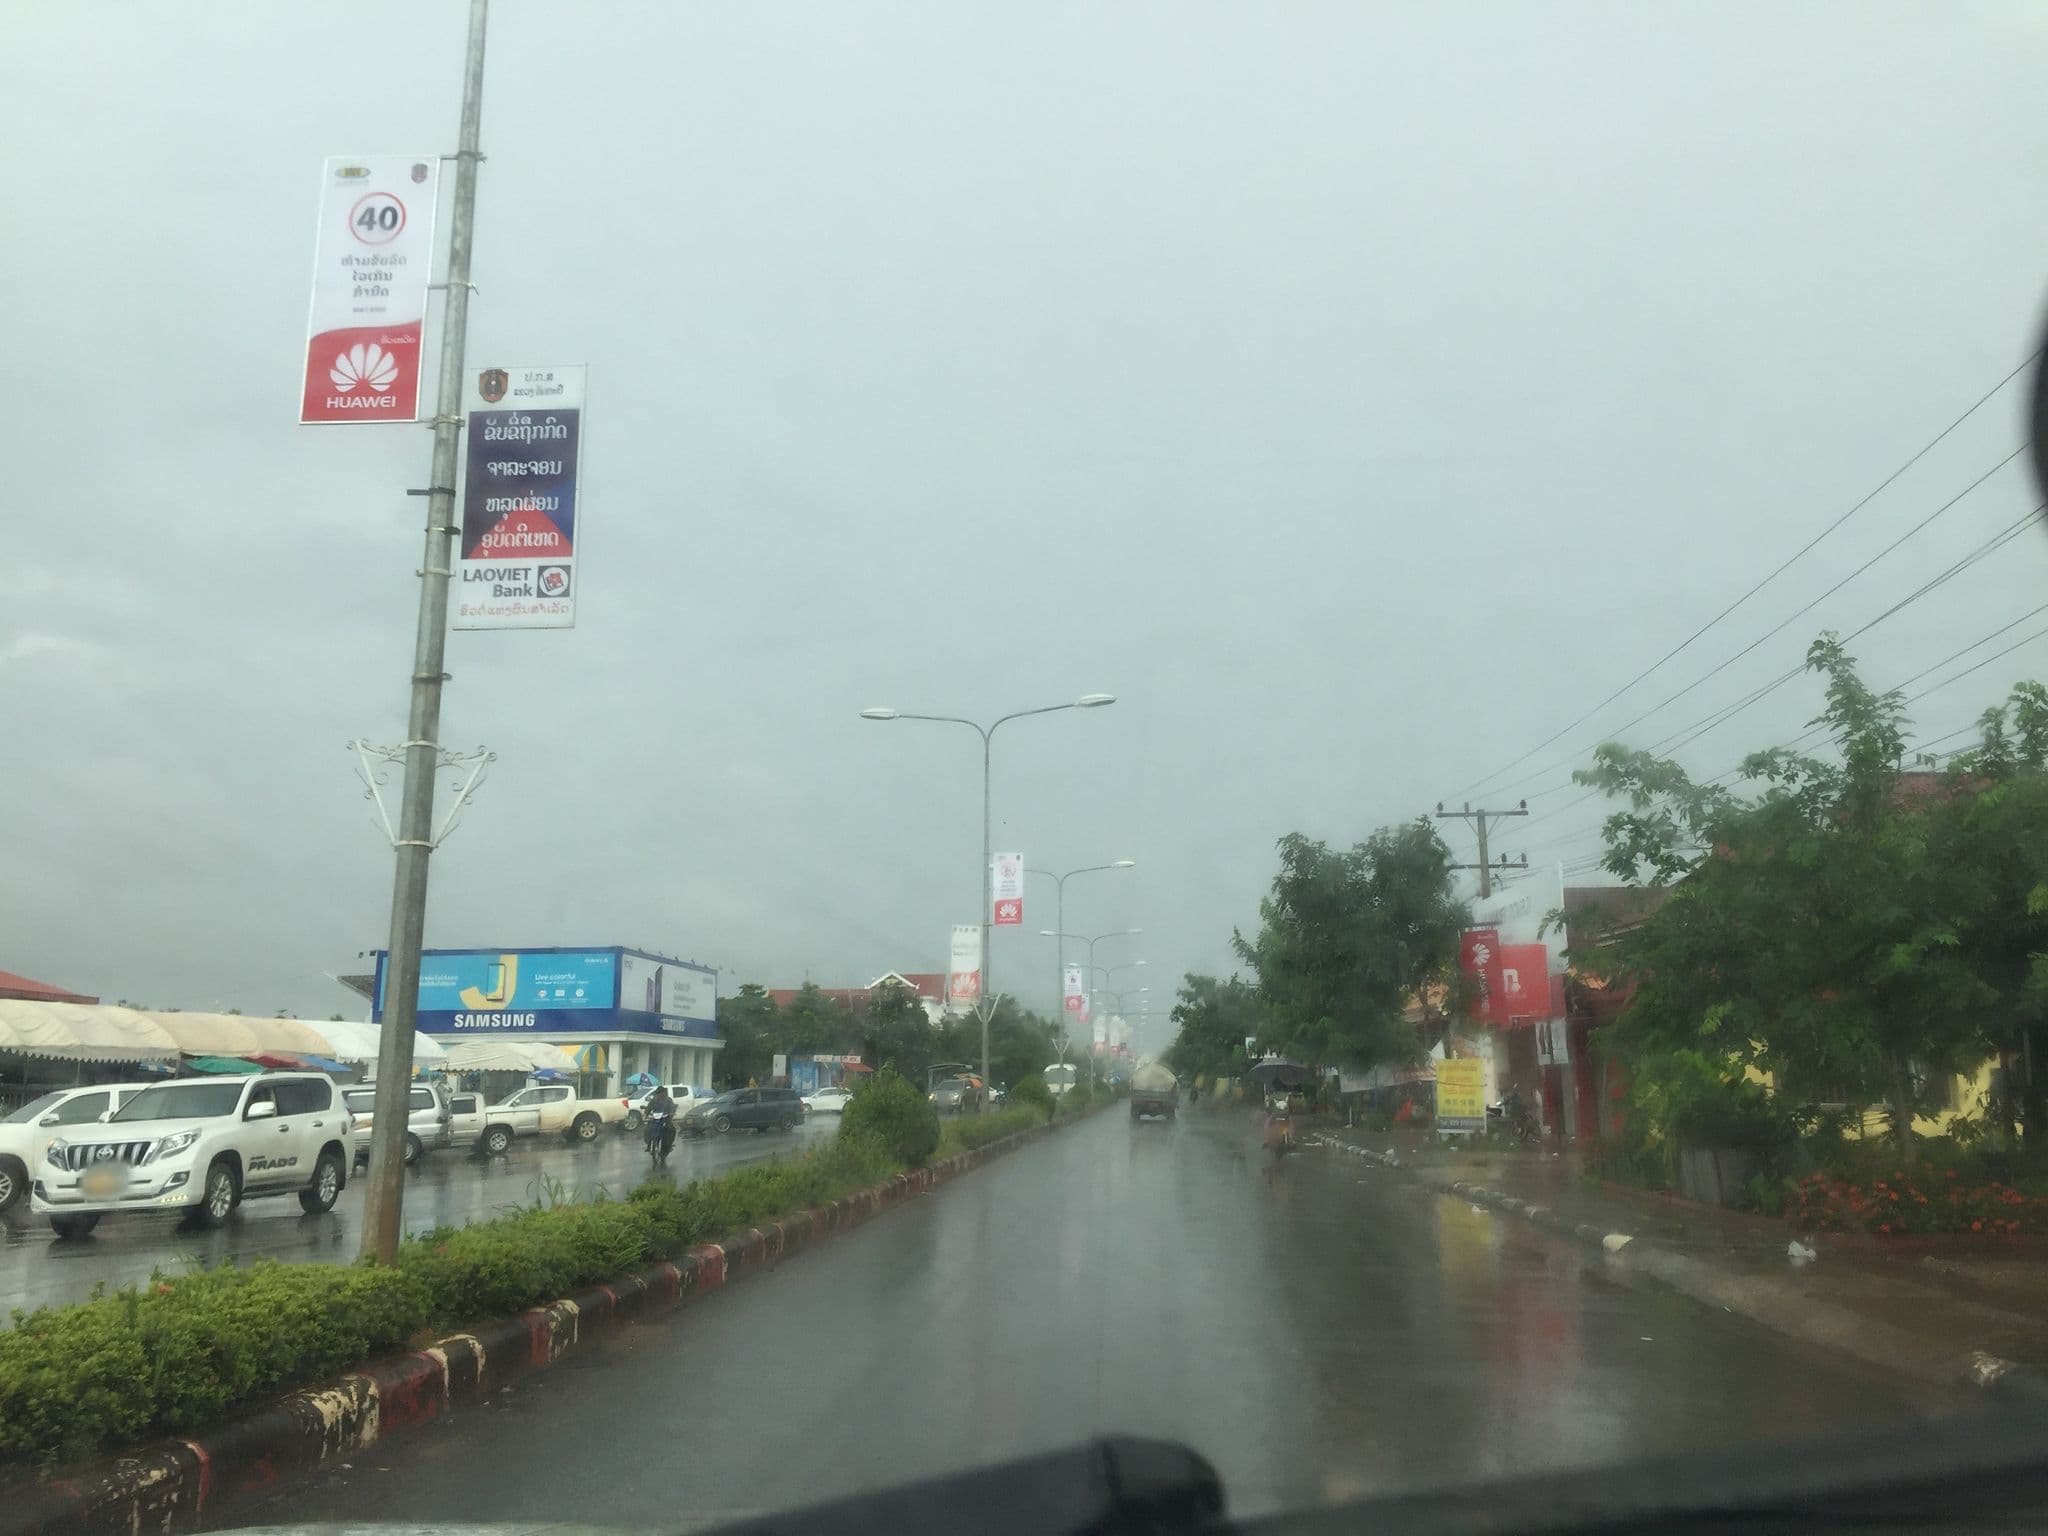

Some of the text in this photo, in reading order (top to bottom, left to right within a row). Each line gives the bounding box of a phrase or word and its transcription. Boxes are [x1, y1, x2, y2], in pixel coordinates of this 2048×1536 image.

[357, 206, 398, 231] 40
[326, 395, 396, 409] HUAWEI
[463, 567, 532, 582] LAOVIET
[493, 583, 533, 598] Bank
[454, 1013, 536, 1029] SAMSUNG
[248, 1157, 297, 1171] PRADO
